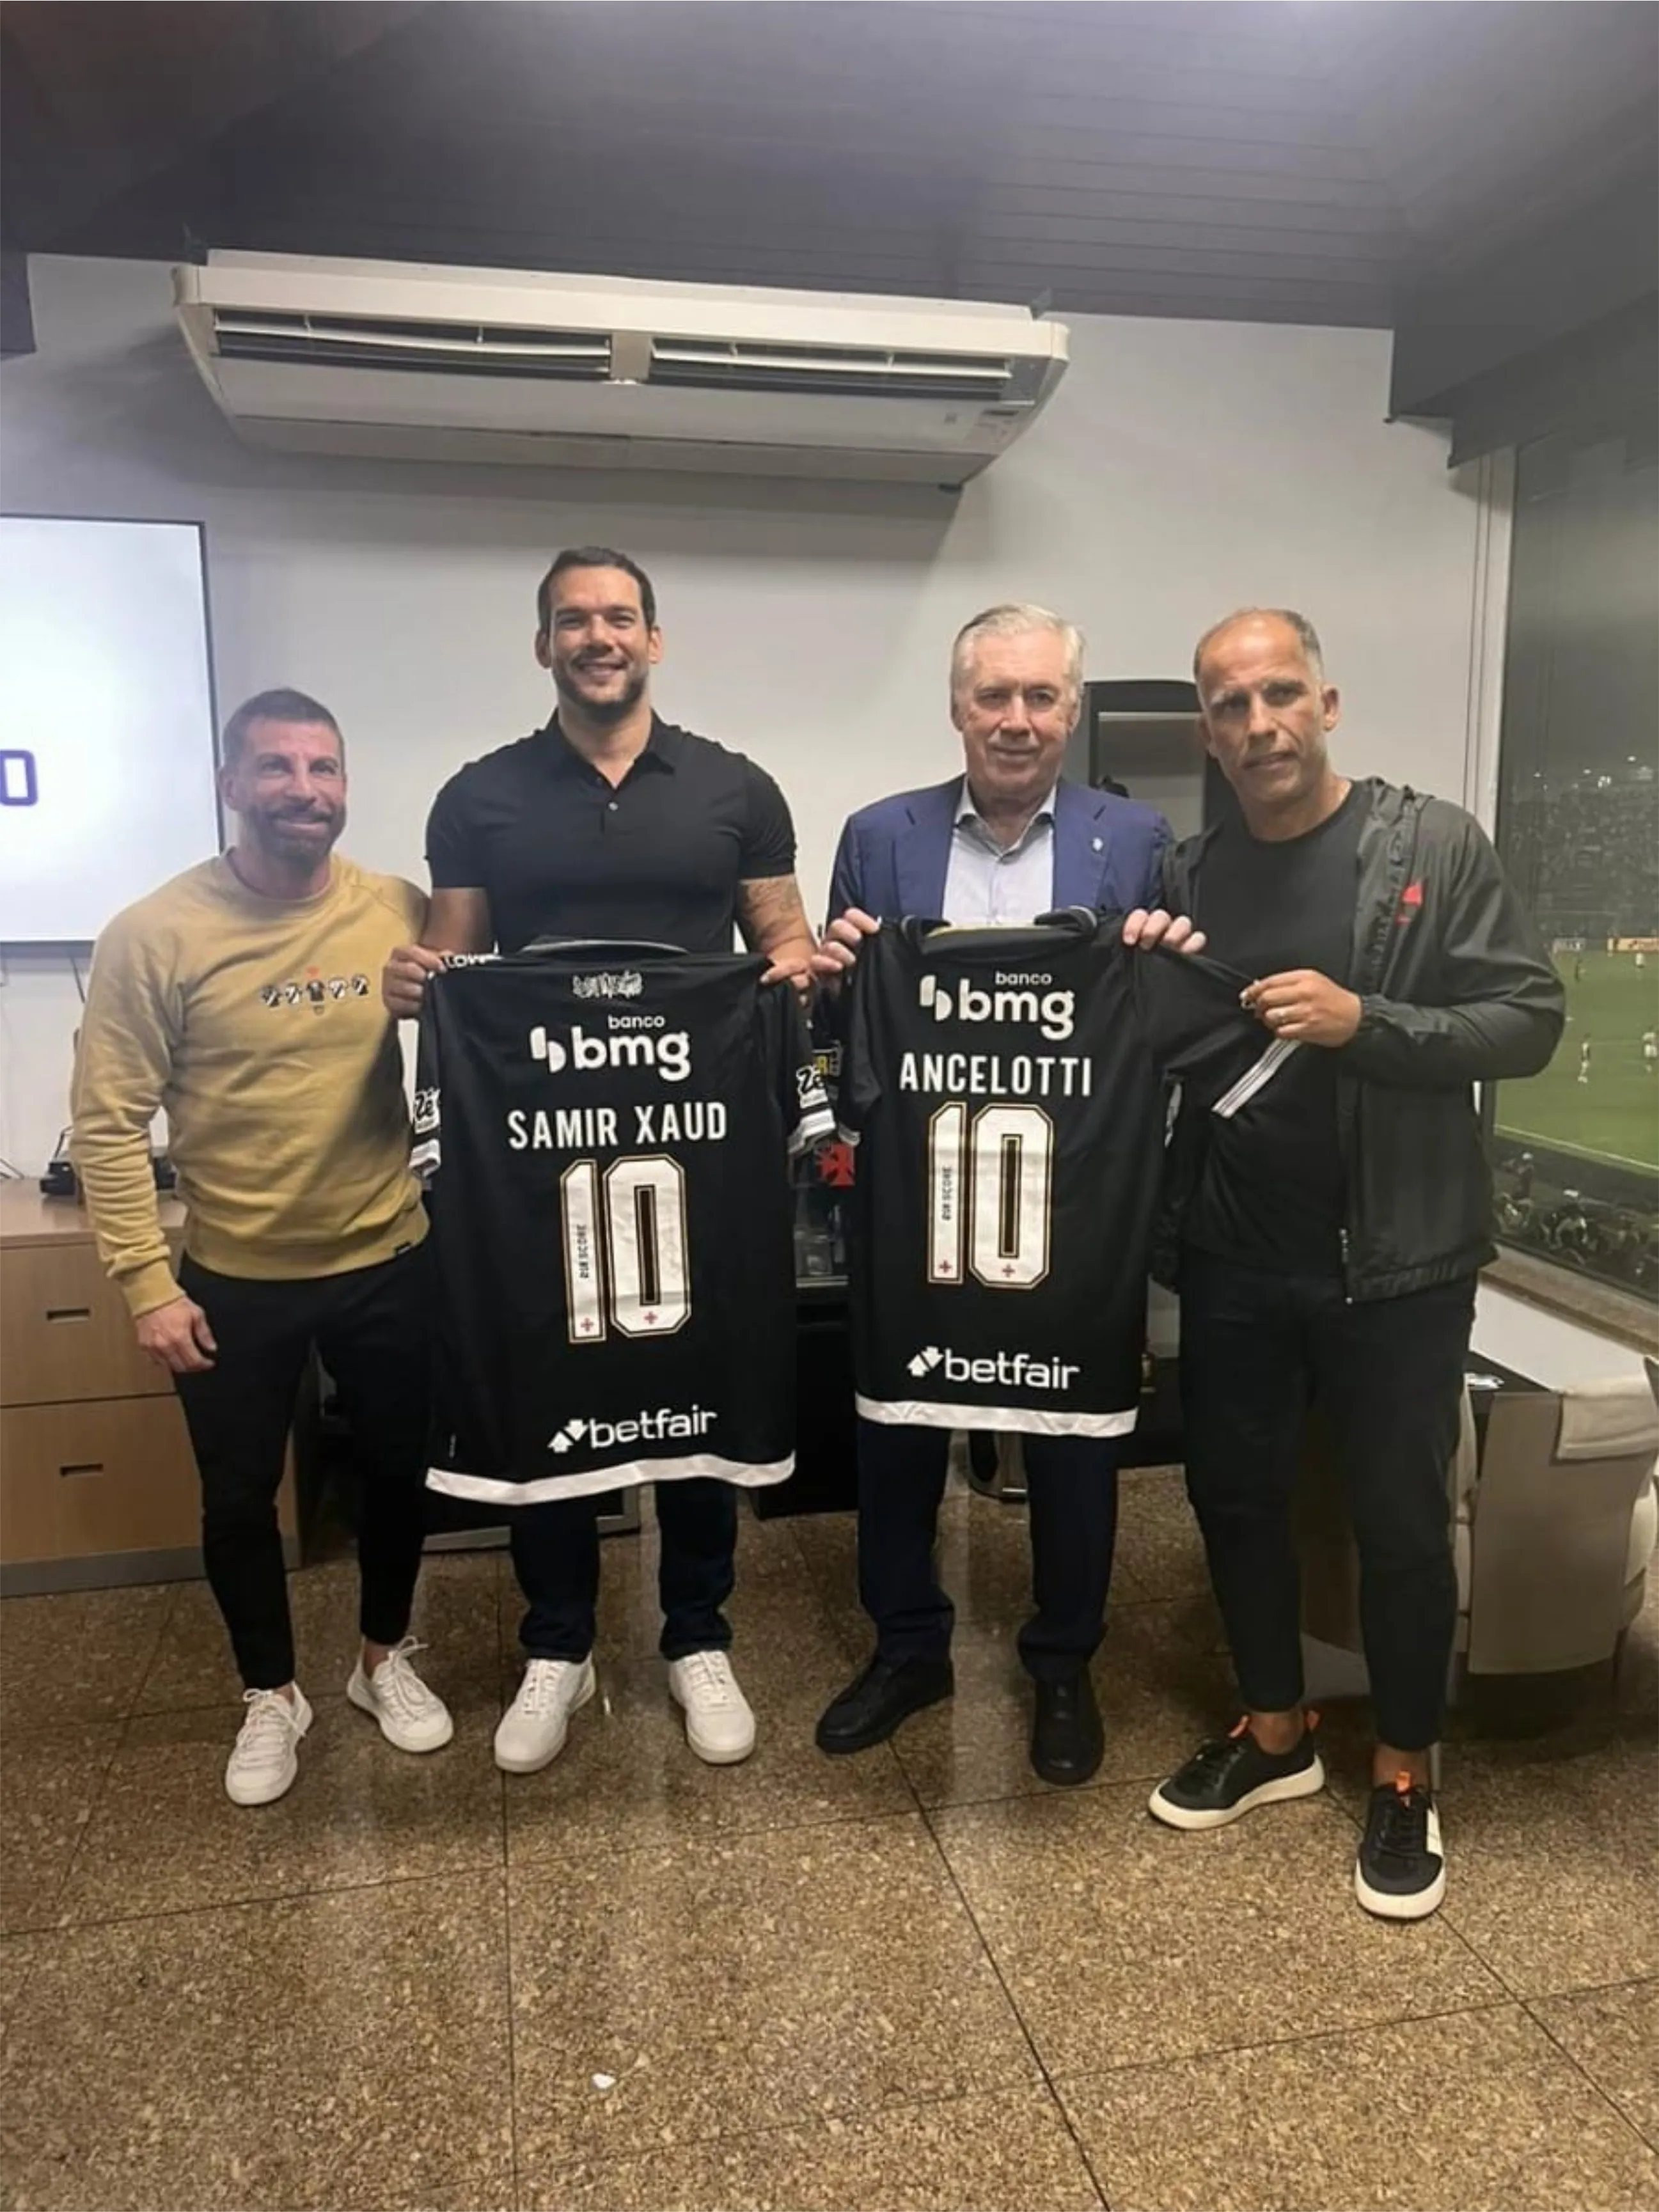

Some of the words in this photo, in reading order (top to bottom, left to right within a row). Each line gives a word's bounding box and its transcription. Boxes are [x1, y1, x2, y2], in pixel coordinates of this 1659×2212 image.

[995, 970, 1053, 985] banco
[608, 1014, 666, 1030] banco
[958, 978, 1076, 1041] bmg
[570, 1025, 691, 1082] bmg
[899, 1052, 1092, 1097] ANCELOTTI
[507, 1108, 619, 1150] SAMIR
[633, 1101, 727, 1144] XAUD
[927, 1101, 1055, 1290] 10
[560, 1154, 692, 1344] 10
[945, 1347, 1080, 1390] betfair
[588, 1404, 718, 1449] betfair
